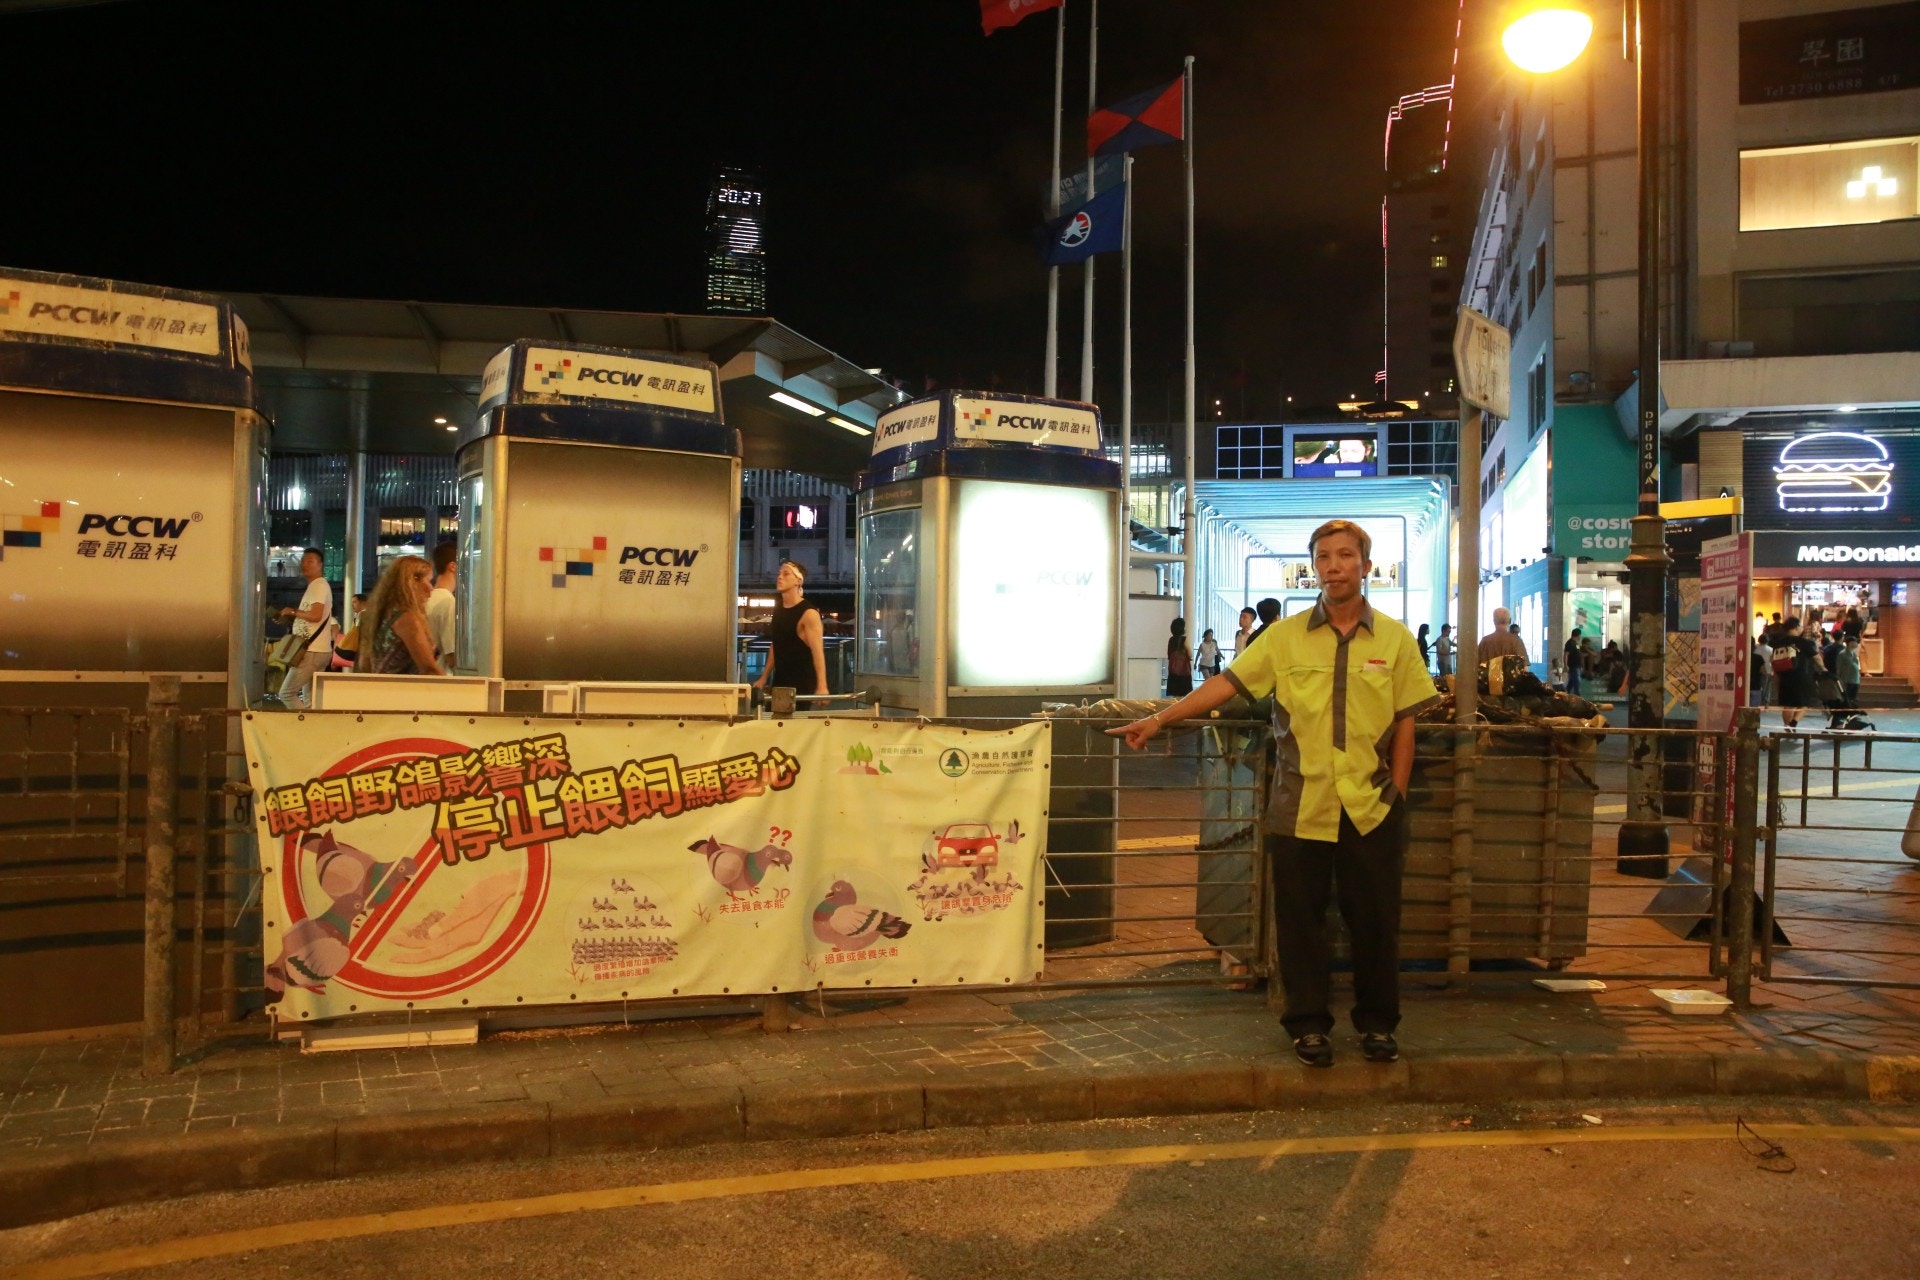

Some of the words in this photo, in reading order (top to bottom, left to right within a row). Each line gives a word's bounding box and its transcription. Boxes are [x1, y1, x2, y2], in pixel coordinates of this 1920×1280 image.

[1800, 38, 1863, 66] 翠園
[719, 188, 761, 205] 20:27
[28, 302, 120, 326] PCCW
[125, 314, 207, 336] 電訊盈科
[578, 367, 644, 388] PCCW
[647, 376, 705, 396] 電訊盈科
[884, 420, 907, 439] PCCW
[905, 414, 936, 430] 電訊盈科
[997, 414, 1047, 431] PCCW
[1048, 419, 1091, 435] 電訊盈科
[1645, 411, 1653, 429] DF
[1644, 433, 1653, 469] 0040
[77, 513, 190, 539] PCCW
[77, 540, 178, 561] 電訊盈科
[1581, 532, 1632, 549] stor
[619, 546, 699, 568] PCCW
[618, 569, 690, 586] 電訊盈科
[263, 732, 571, 837] 餵飼野鴿影響深
[432, 747, 801, 865] 停止餵飼顯愛心
[825, 947, 899, 964] 過重或營養失衡
